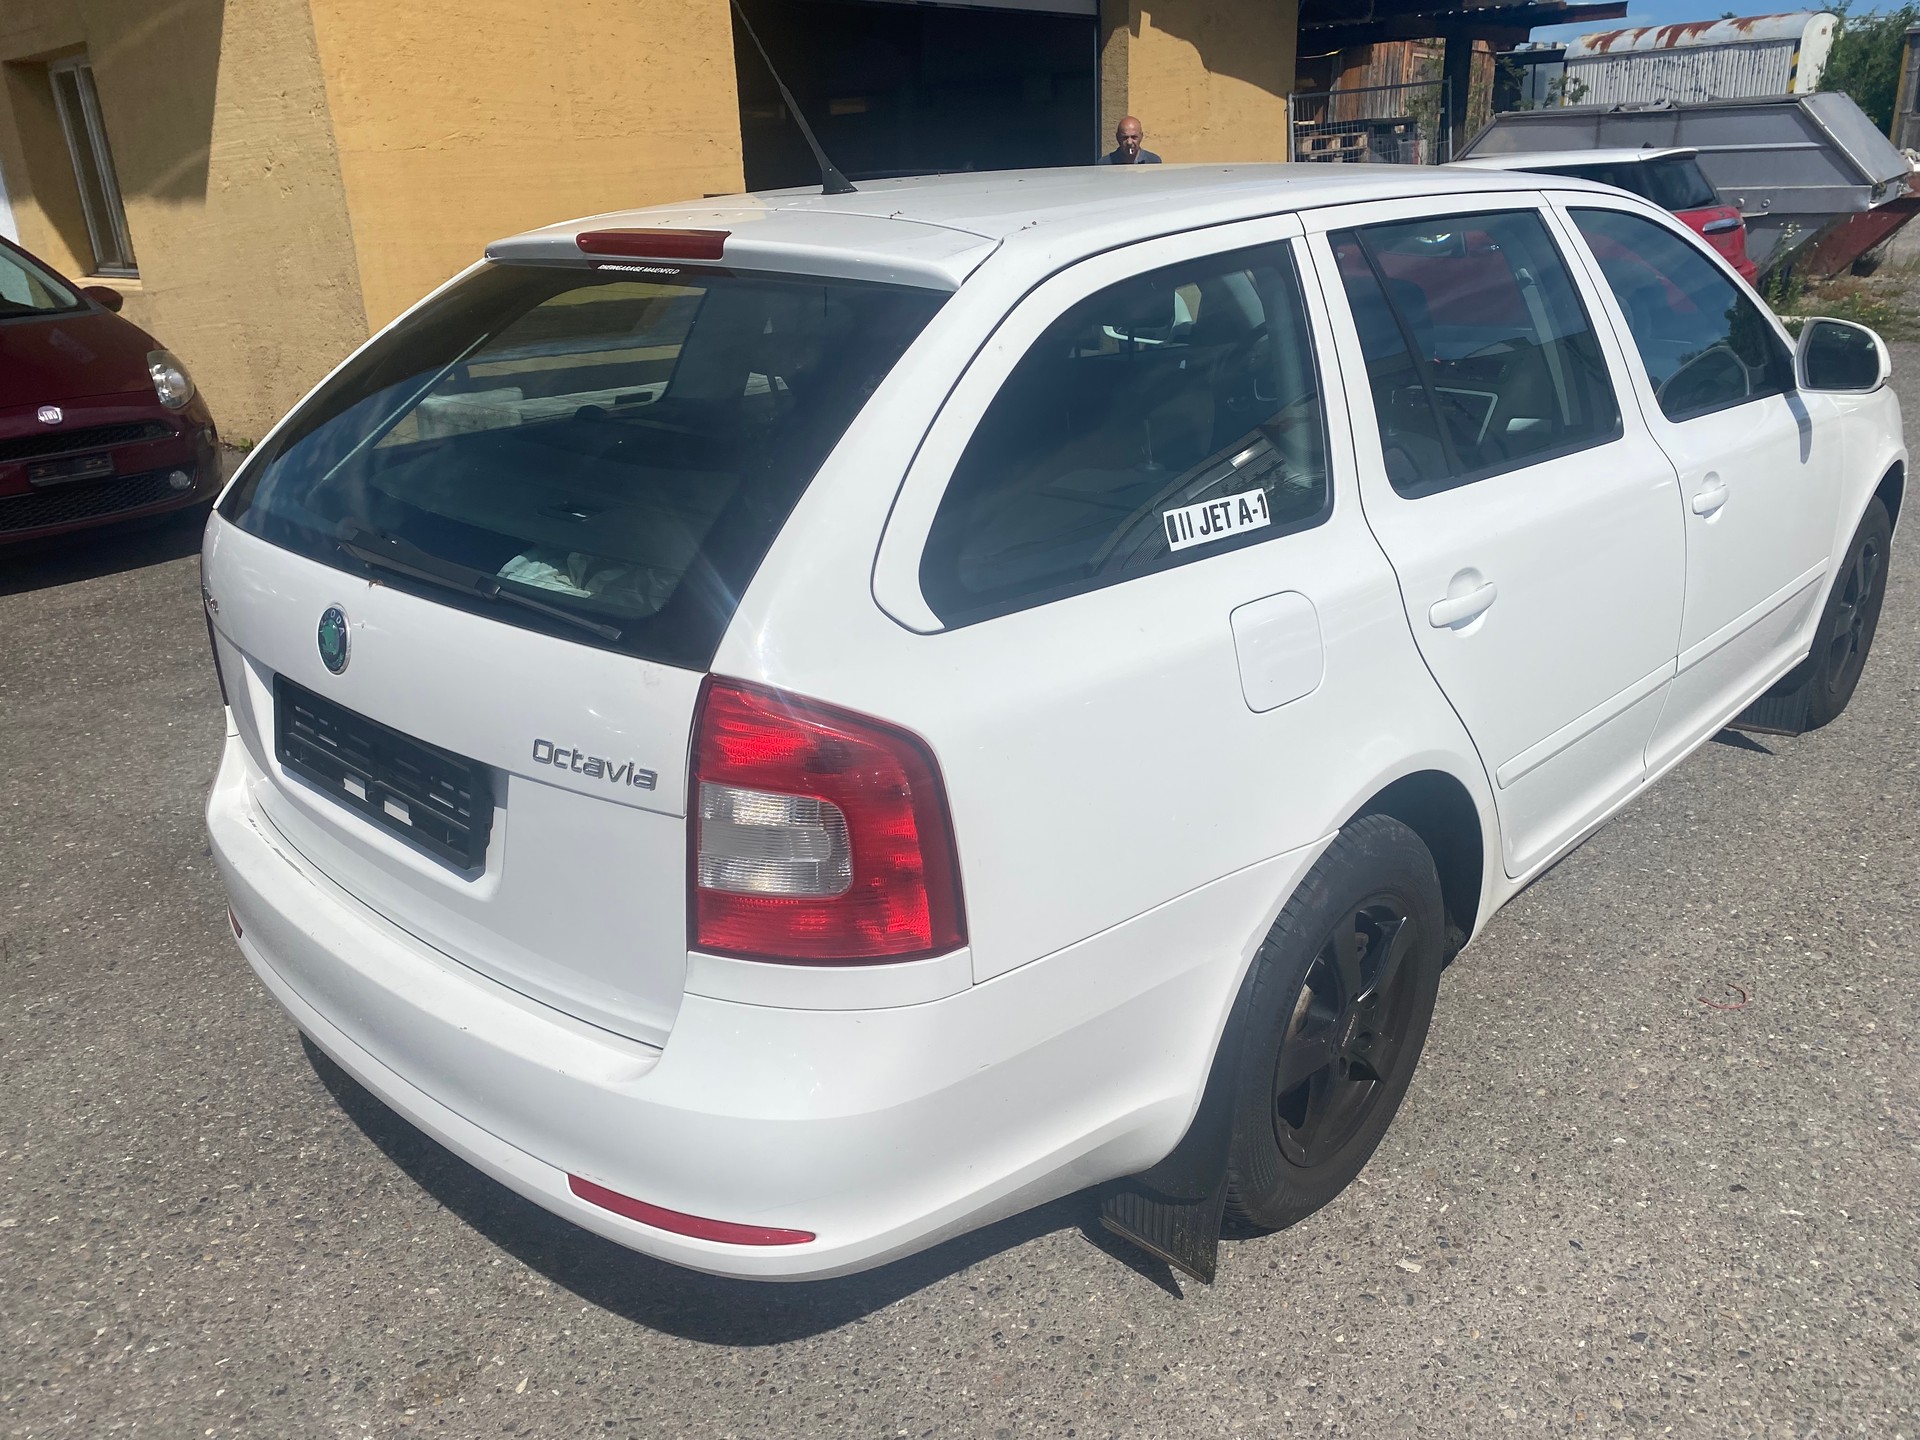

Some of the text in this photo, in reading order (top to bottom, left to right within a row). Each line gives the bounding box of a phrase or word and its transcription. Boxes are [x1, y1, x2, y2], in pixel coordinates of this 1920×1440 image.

[1199, 493, 1268, 536] JET A-1
[532, 738, 658, 791] Octavia
